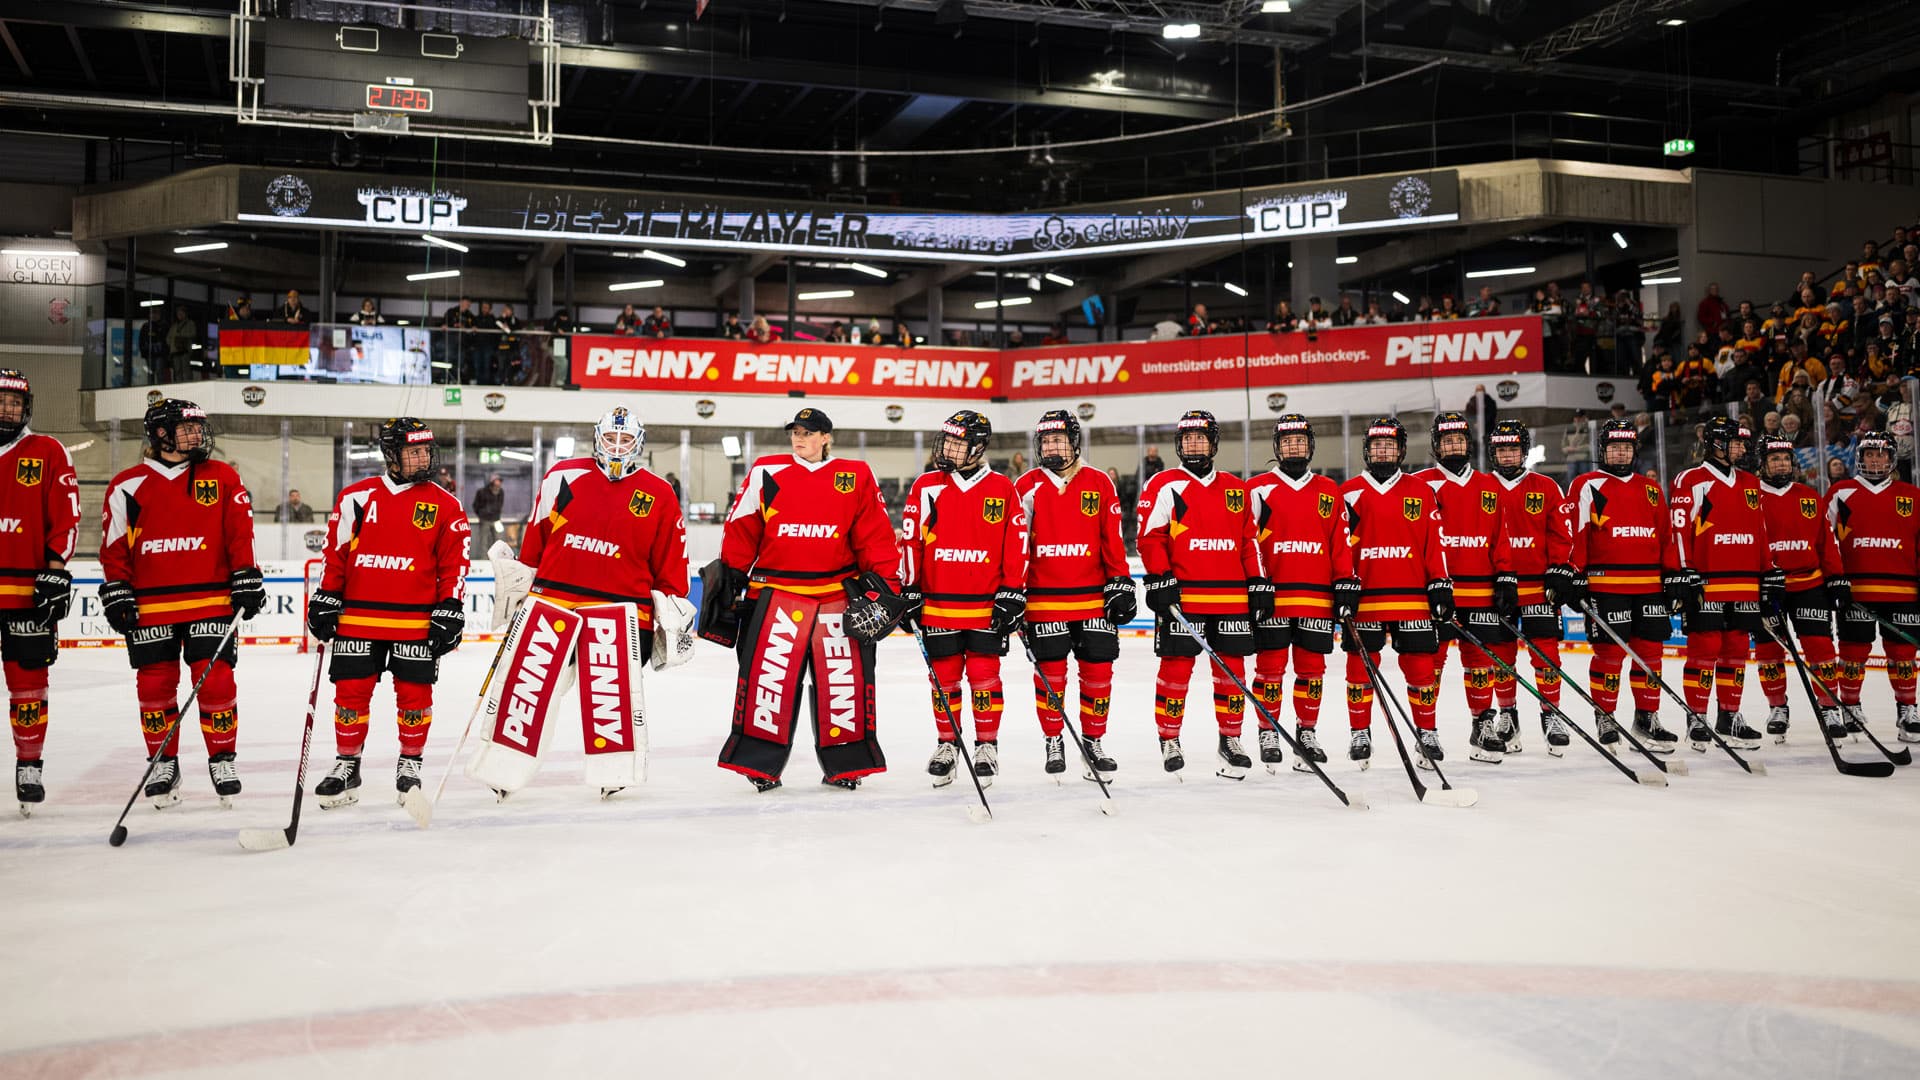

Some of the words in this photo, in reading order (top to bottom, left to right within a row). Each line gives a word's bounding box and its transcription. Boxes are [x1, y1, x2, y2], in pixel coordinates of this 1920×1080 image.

[368, 87, 428, 110] 21:26
[372, 196, 453, 224] CUP
[1260, 202, 1333, 232] CUP
[16, 257, 72, 271] LOGEN
[1142, 358, 1212, 374] Unterstützer
[1214, 356, 1235, 370] des
[1237, 351, 1299, 369] Deutschen
[1301, 348, 1371, 365] Eishockeys.
[365, 500, 378, 524] A
[902, 518, 915, 540] 9
[732, 676, 748, 727] CCM
[866, 683, 877, 732] CCM
